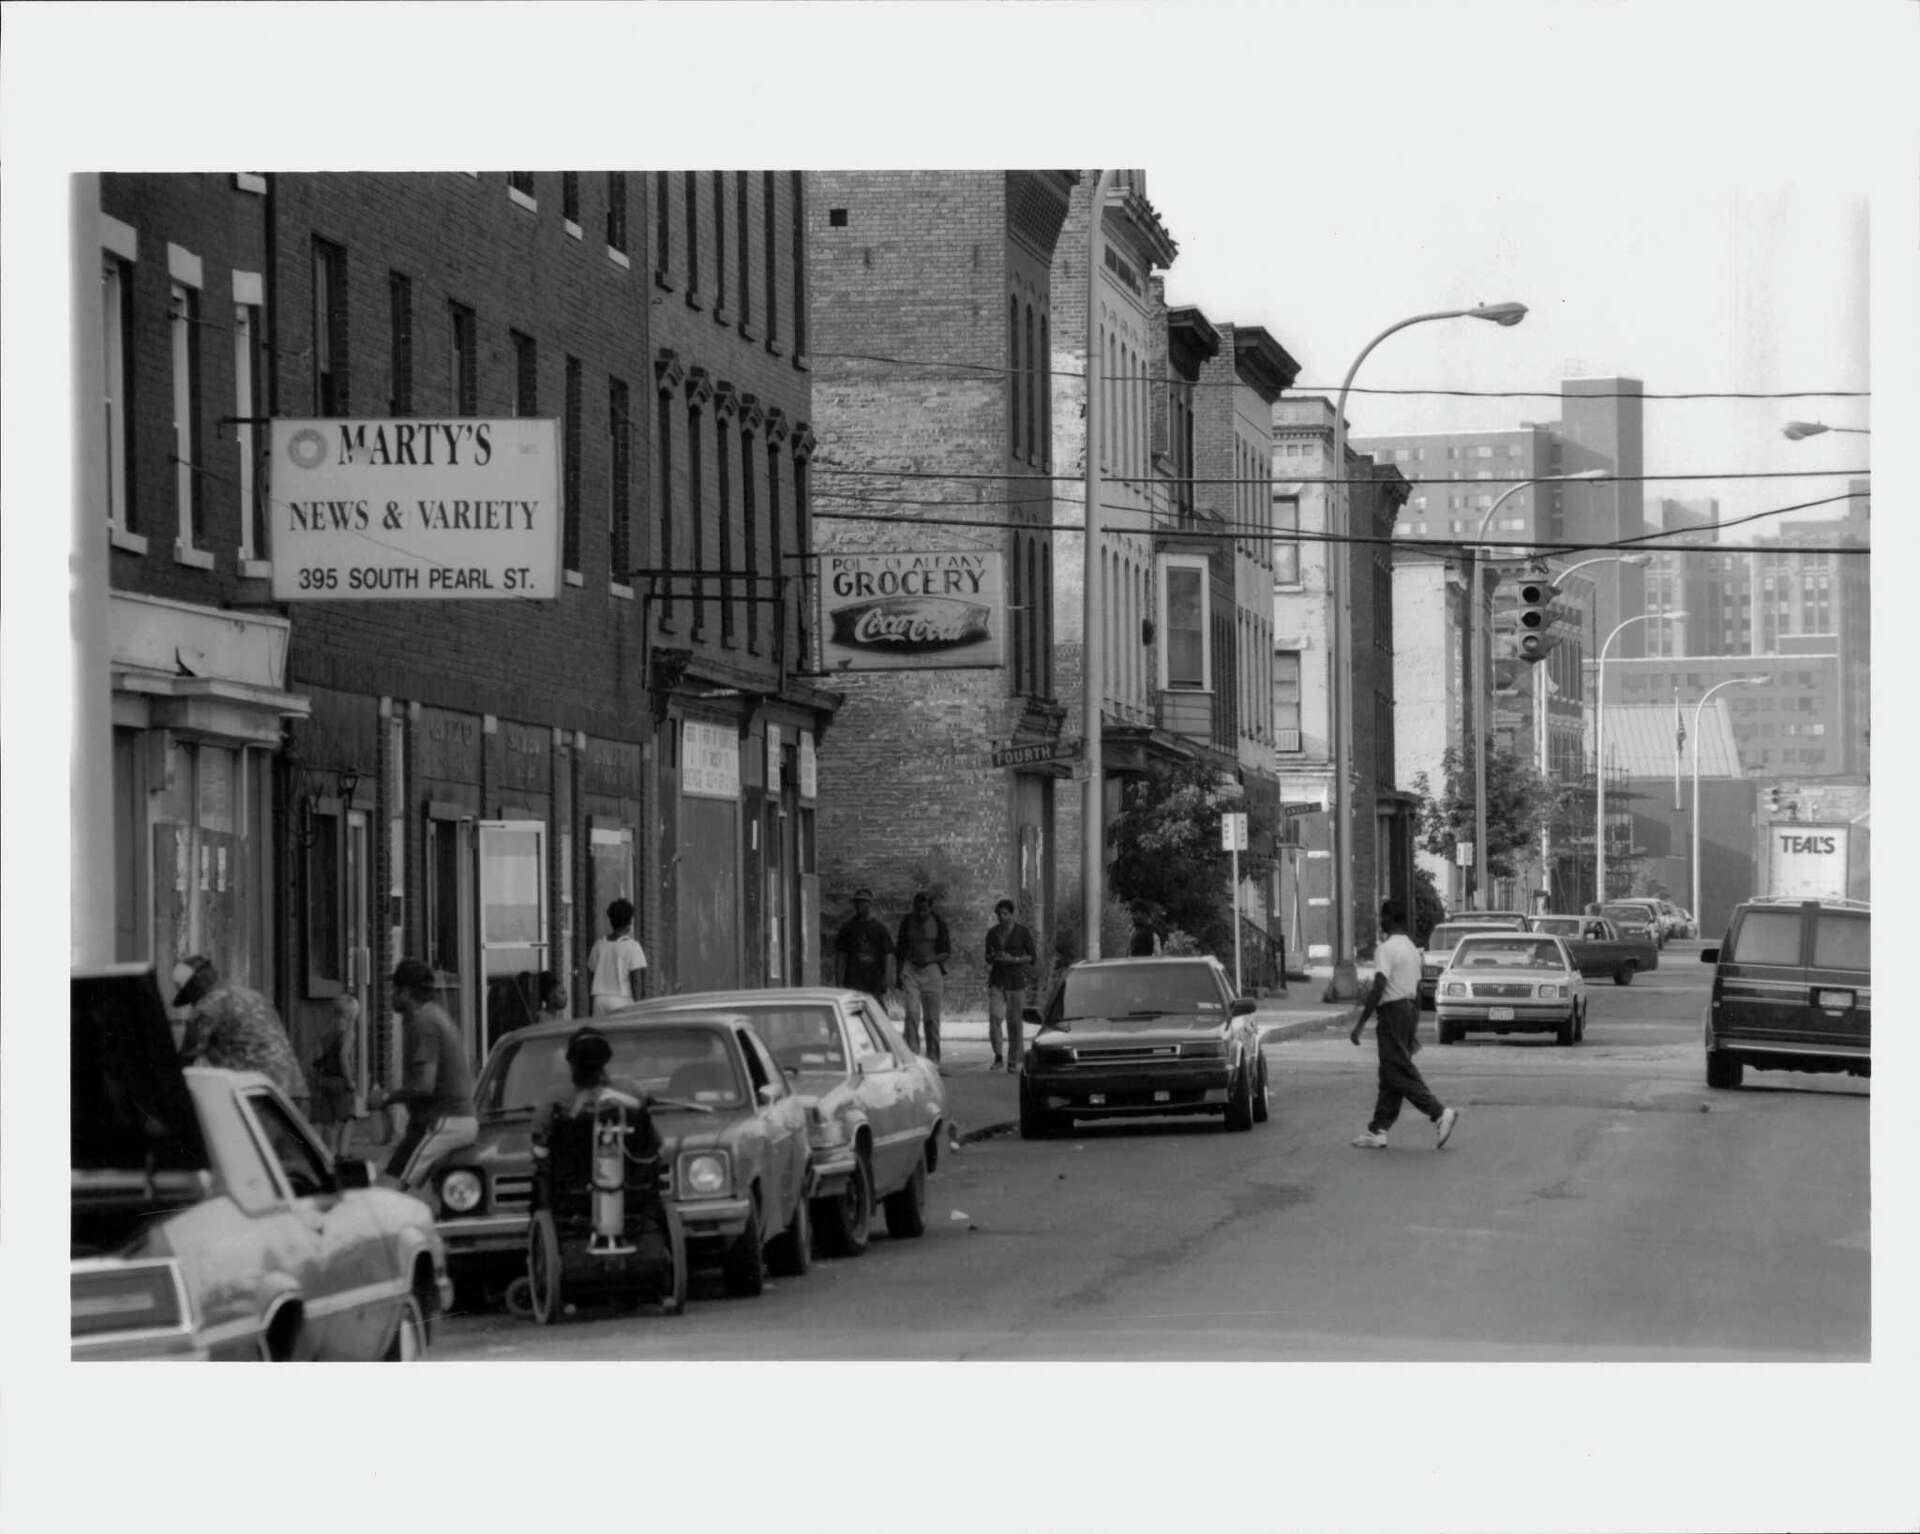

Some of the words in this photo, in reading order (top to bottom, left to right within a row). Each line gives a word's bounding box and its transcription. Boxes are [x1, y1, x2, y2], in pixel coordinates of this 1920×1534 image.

[337, 423, 492, 465] MARTY'S
[289, 500, 369, 531] NEWS
[382, 500, 403, 530] &
[418, 500, 539, 530] VARIETY
[832, 557, 879, 571] PO
[299, 568, 338, 590] 395
[349, 568, 419, 590] SOUTH
[430, 568, 493, 589] PEARL
[503, 568, 535, 590] ST.
[833, 569, 986, 597] GROCERY
[996, 746, 1051, 765] FOURTH
[1780, 835, 1836, 854] TEAL'S
